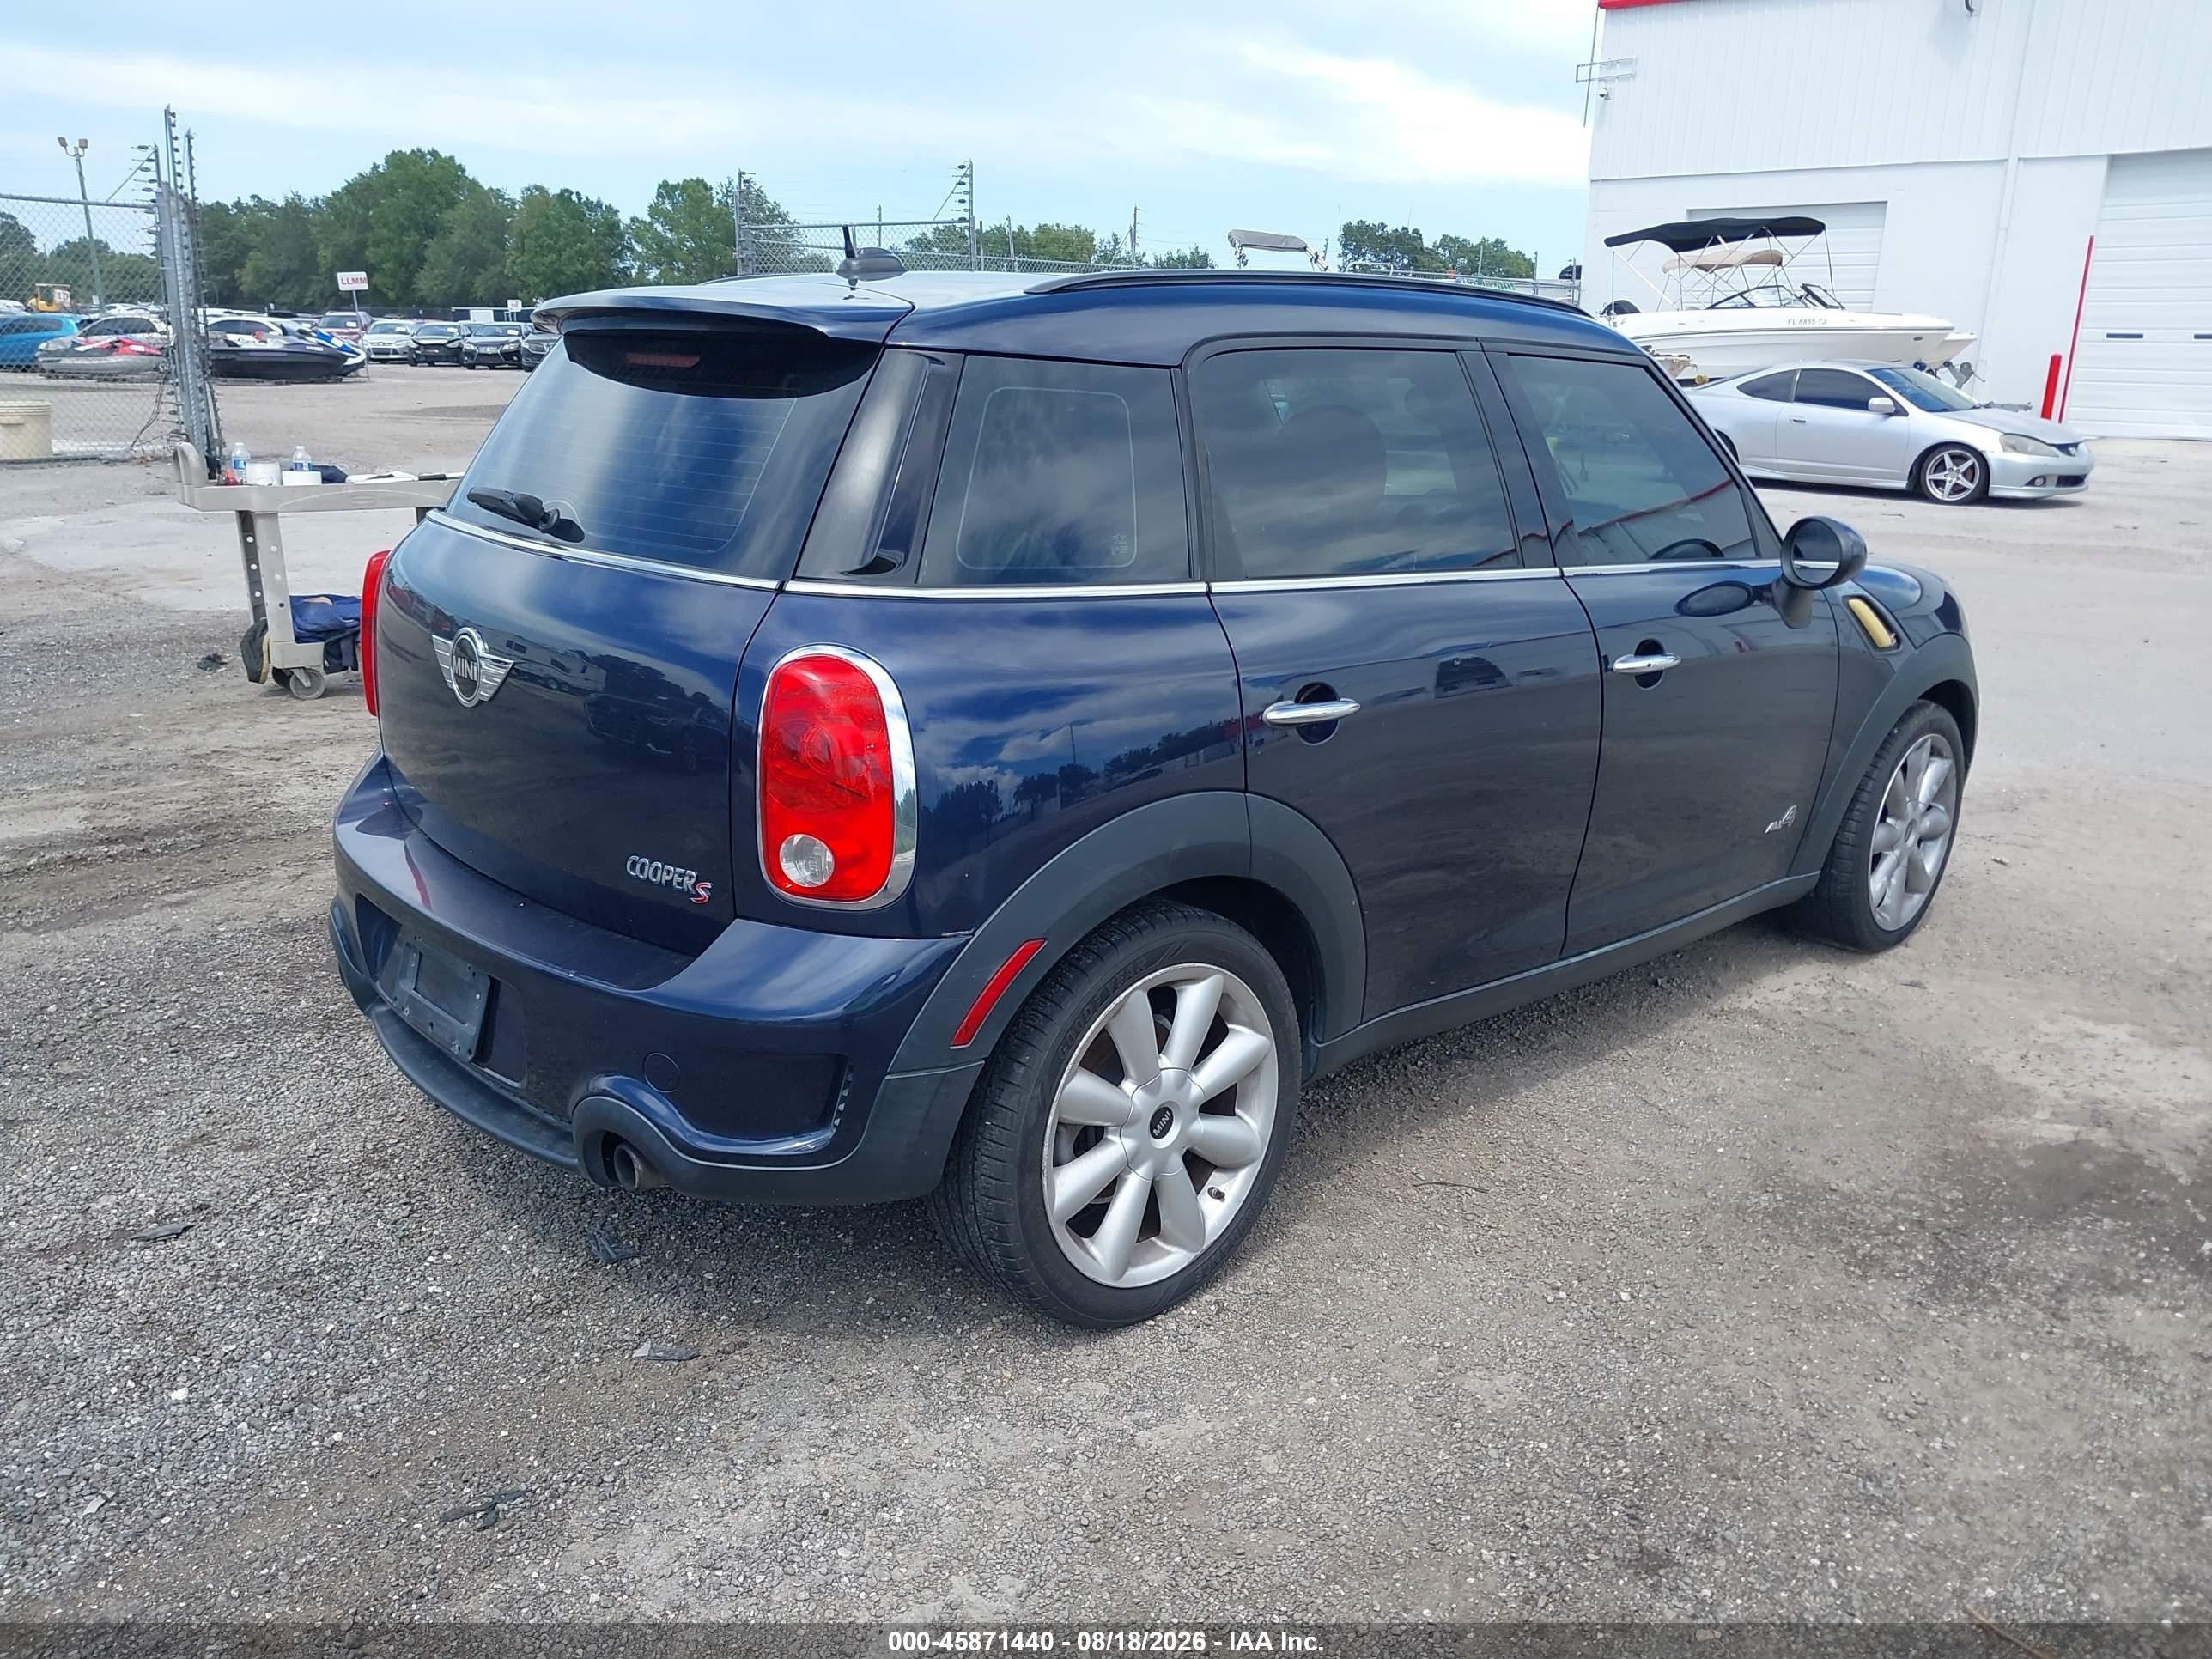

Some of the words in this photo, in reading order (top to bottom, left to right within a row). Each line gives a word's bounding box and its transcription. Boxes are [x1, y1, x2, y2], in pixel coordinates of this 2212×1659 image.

[453, 655, 477, 682] MINI
[626, 855, 696, 895] COOPER
[689, 882, 712, 904] S
[1152, 1110, 1171, 1136] MINI
